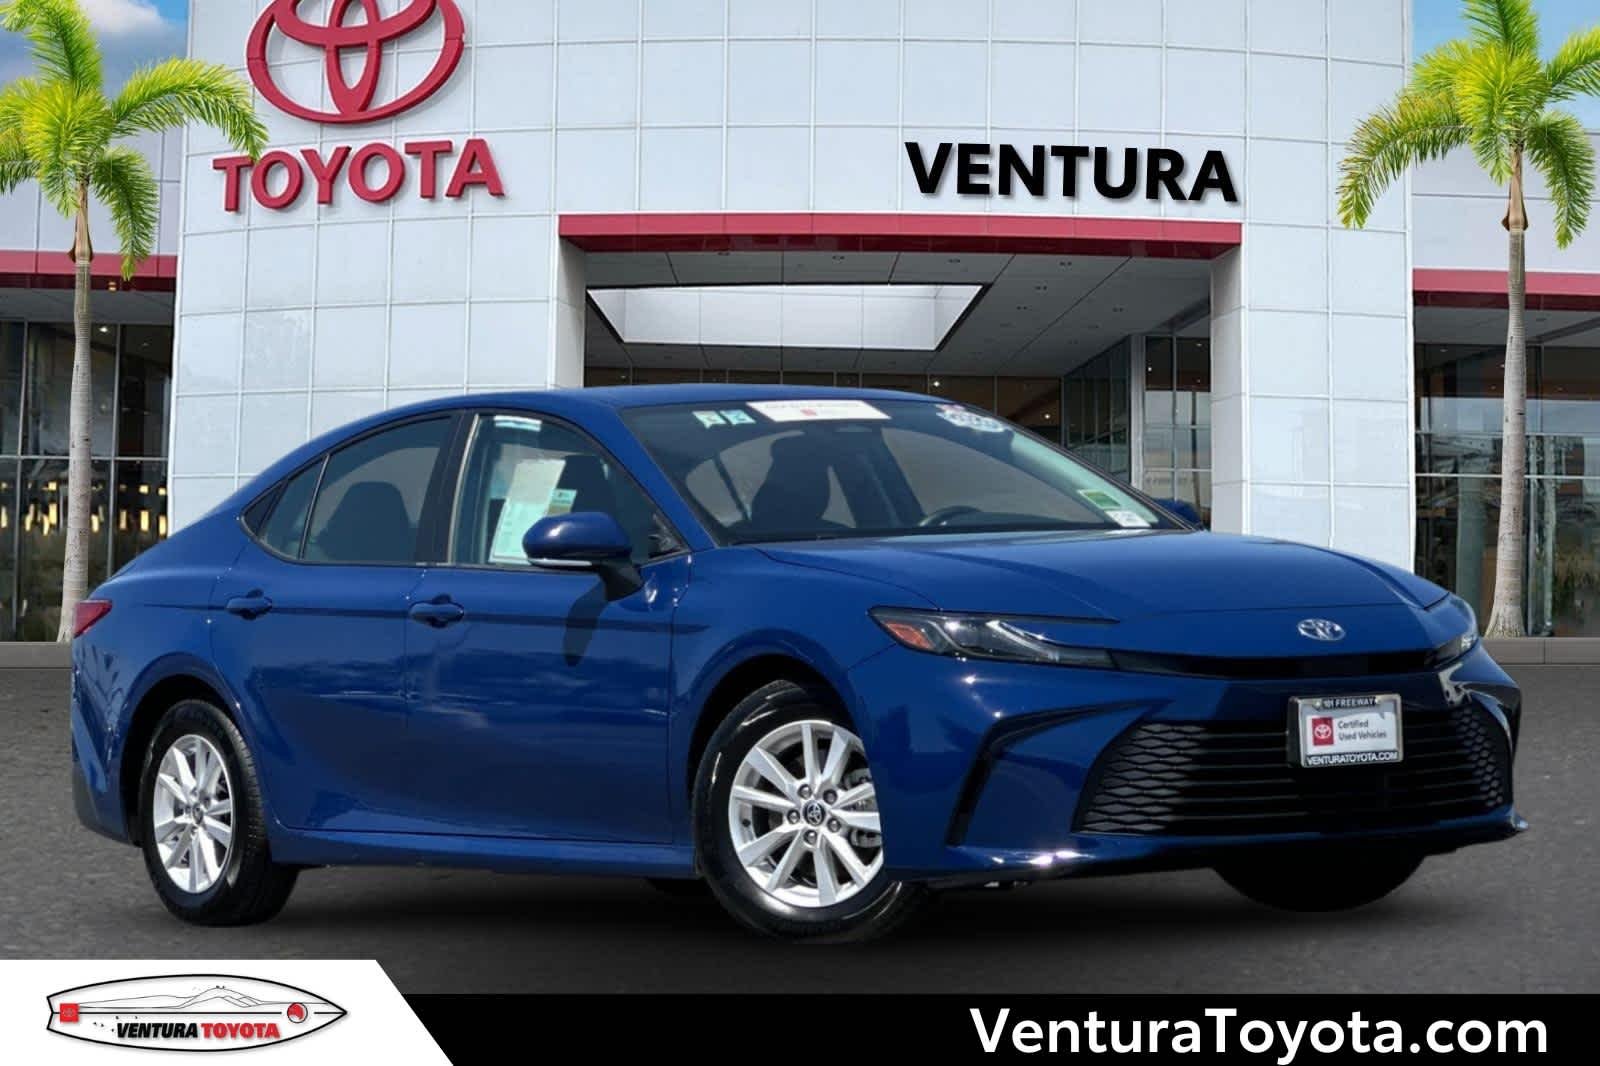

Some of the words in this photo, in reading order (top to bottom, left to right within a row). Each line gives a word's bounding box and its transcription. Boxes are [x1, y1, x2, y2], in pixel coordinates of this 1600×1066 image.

[213, 139, 504, 212] TOYOTA
[905, 142, 1238, 203] VENTURA
[1335, 697, 1373, 707] FREEWAY
[1338, 719, 1369, 729] Certified
[1339, 732, 1358, 740] Used
[1359, 731, 1387, 740] Vehicles
[1307, 752, 1398, 766] VENTURATOYOTA.COM
